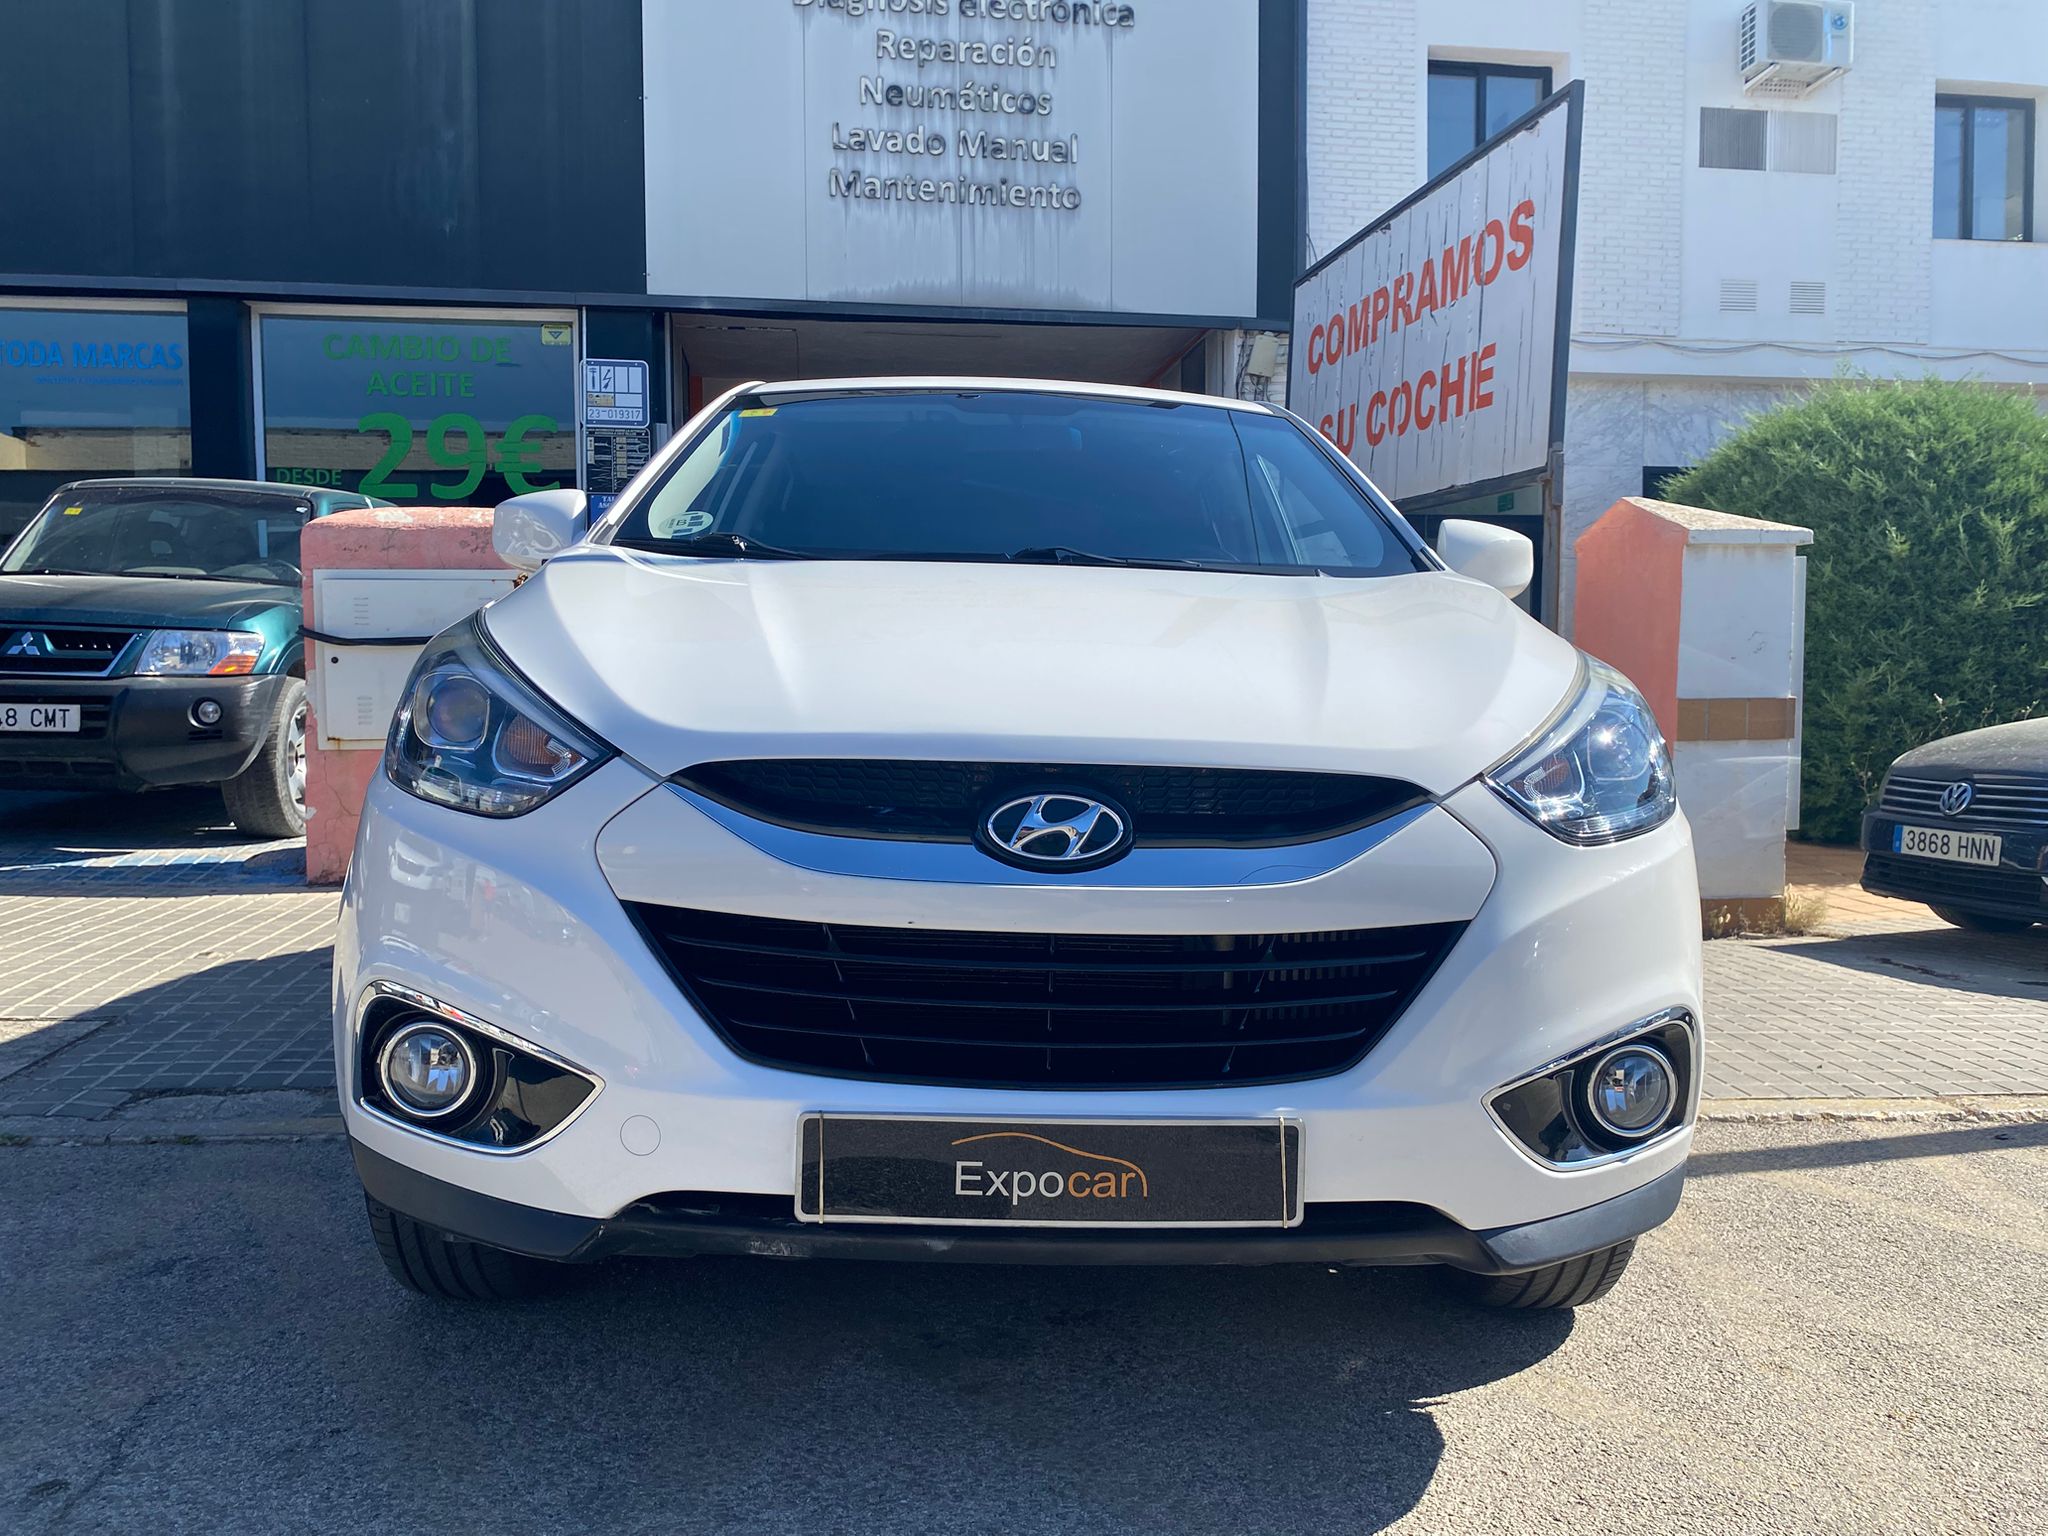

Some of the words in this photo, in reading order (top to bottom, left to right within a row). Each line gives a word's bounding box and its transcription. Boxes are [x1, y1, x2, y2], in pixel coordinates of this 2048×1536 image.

[876, 28, 1056, 68] Reparación
[860, 75, 1052, 115] Neumáticos
[831, 122, 946, 156] Lavado
[958, 129, 1078, 164] Manual
[829, 167, 1081, 209] Mantenimiento
[1307, 199, 1536, 375] COMPRAMOS
[72, 341, 184, 370] MARCAS
[323, 333, 461, 362] CAMBIO
[471, 336, 512, 364] DE
[366, 371, 475, 397] ACEITE
[1319, 402, 1355, 457] SU
[1366, 343, 1497, 447] COCHE
[276, 468, 342, 486] DESDE
[358, 412, 560, 500] 29€
[31, 708, 70, 728] CMT
[1906, 830, 1950, 855] 3868
[1957, 836, 1996, 861] HNN
[954, 1160, 1137, 1205] Expocar
